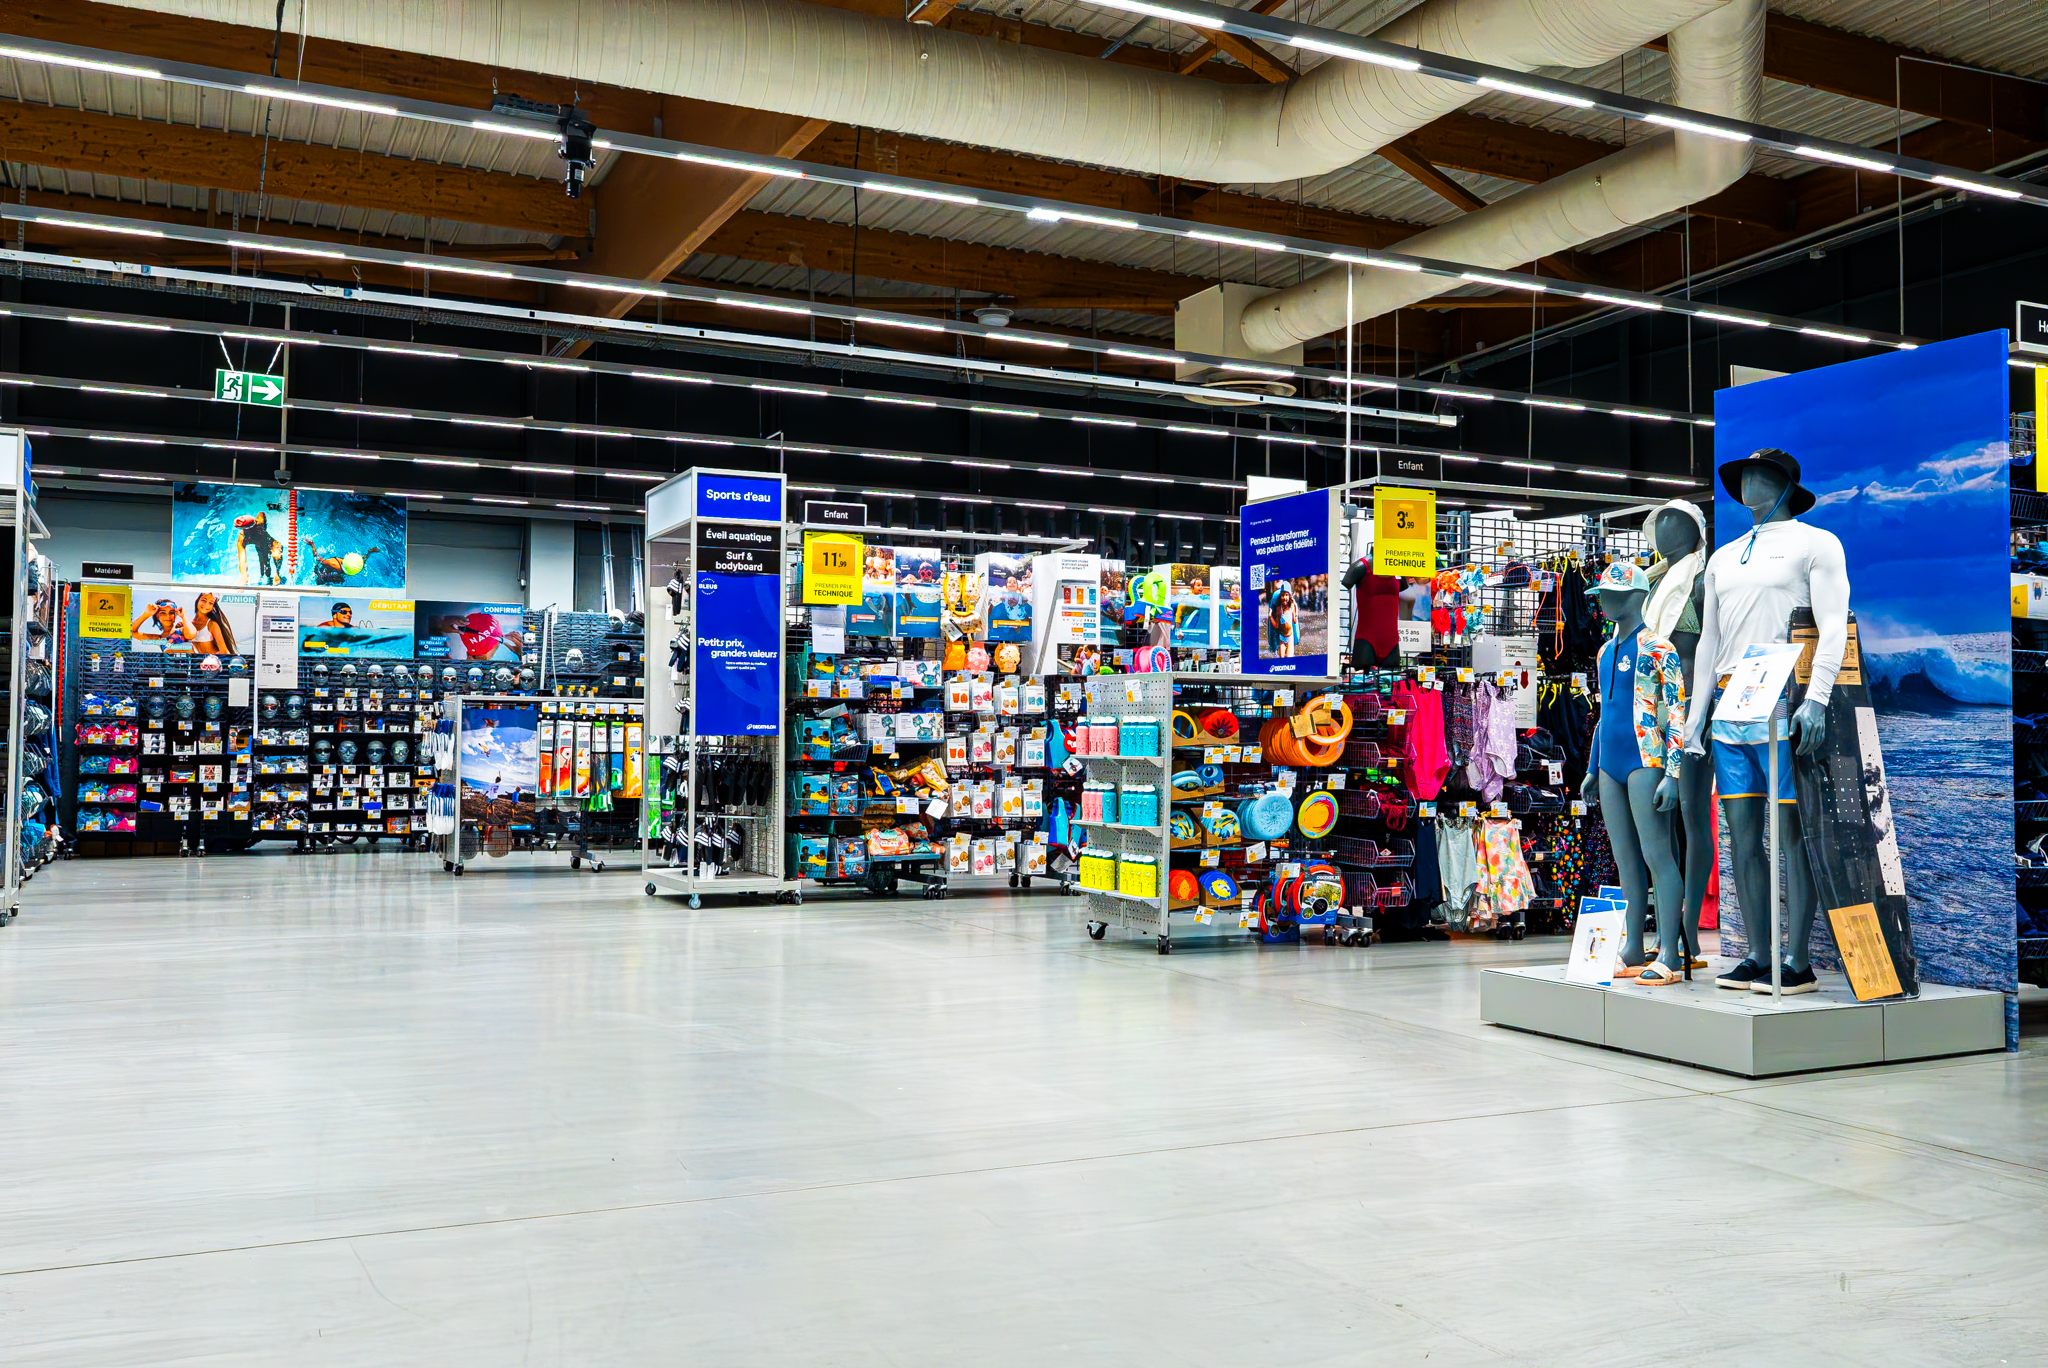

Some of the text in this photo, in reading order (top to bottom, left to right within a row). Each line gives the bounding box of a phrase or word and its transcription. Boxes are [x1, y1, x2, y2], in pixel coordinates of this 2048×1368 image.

[1398, 460, 1424, 471] Enfant
[706, 489, 771, 502] Sports d'eau
[824, 510, 848, 519] Enfant
[706, 528, 772, 543] Éveil aquatique
[1250, 529, 1309, 546] Pensez à transformer
[1266, 544, 1284, 556] points
[1285, 542, 1293, 551] de
[1293, 538, 1314, 549] fidélité
[726, 551, 753, 560] Surf &
[715, 561, 763, 572] bodyboard
[1384, 558, 1426, 568] TECHNIQUE
[814, 590, 853, 598] TECHNIQUE
[698, 637, 745, 649] Petits prix,
[711, 649, 777, 658] grandes valeurs
